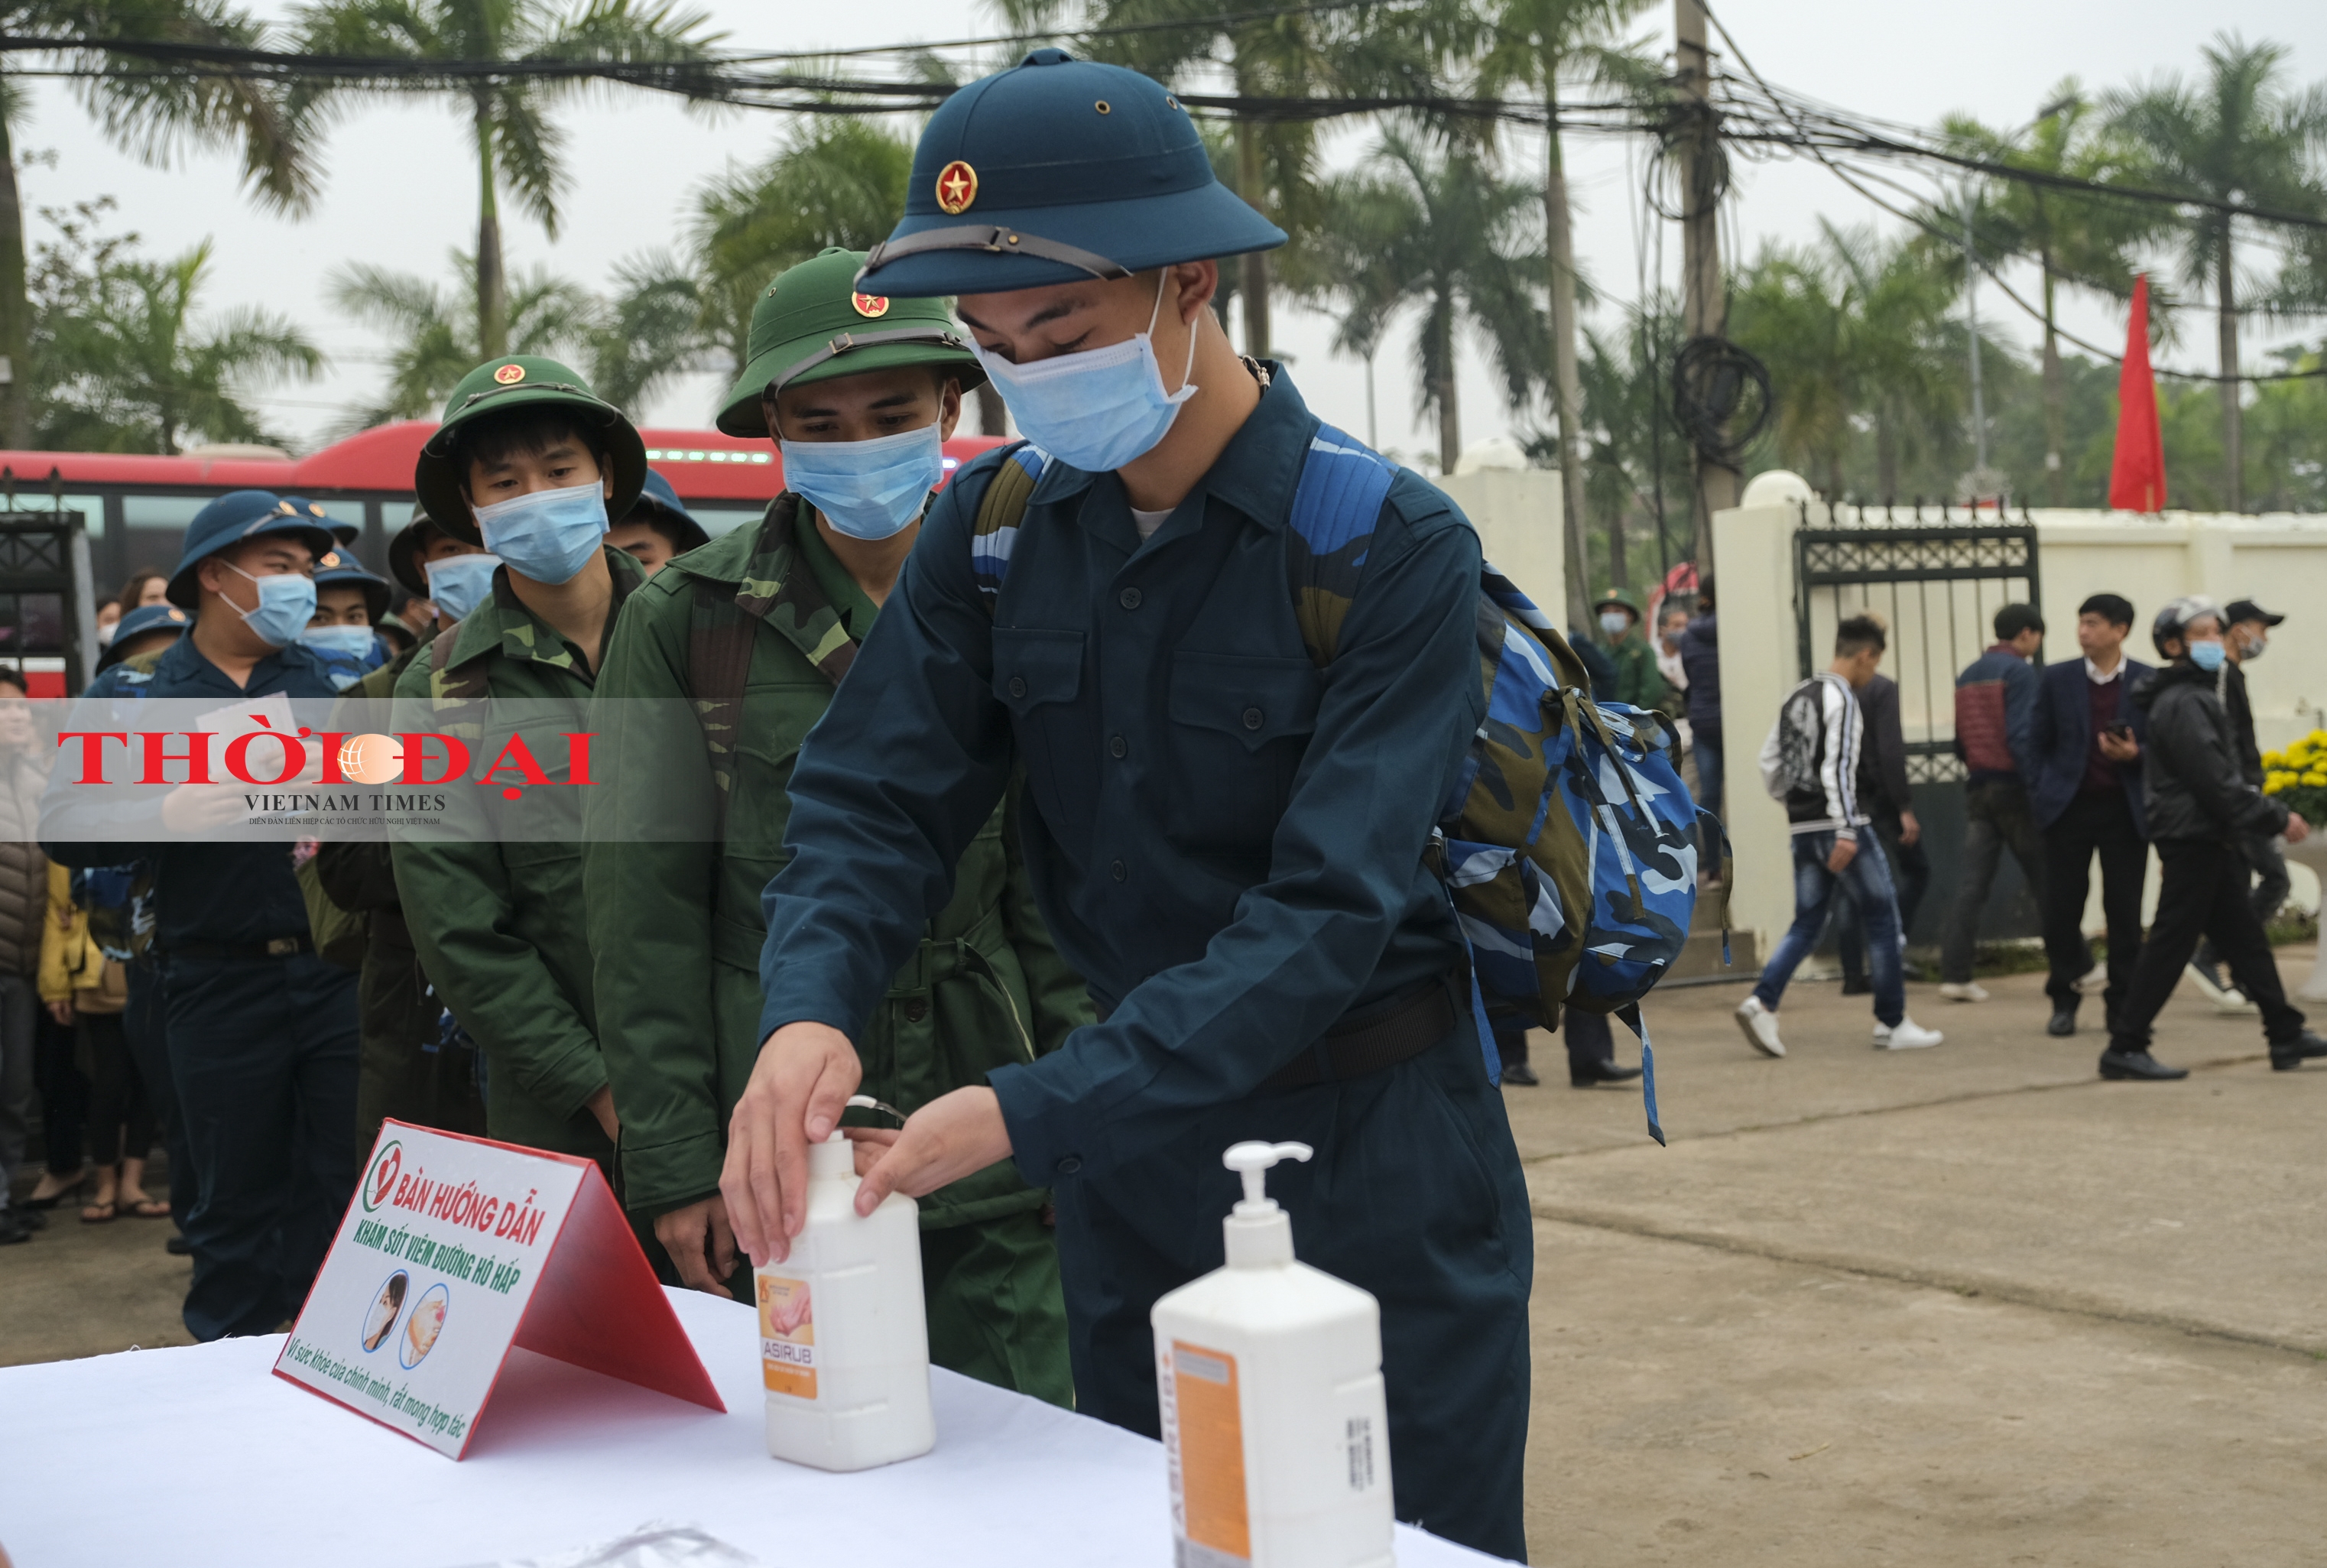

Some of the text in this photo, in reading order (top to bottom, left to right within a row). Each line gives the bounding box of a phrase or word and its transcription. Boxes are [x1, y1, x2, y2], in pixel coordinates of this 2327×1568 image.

[392, 1166, 546, 1246] BÀN HƯỚNG DẪN
[353, 1218, 521, 1295] KHÁM SỐT VIÊM ĐƯỜNG HÔ HẤP
[287, 1337, 301, 1358] Vì
[294, 1343, 313, 1365] sức
[309, 1348, 332, 1374] khỏe
[329, 1358, 346, 1381] của
[344, 1365, 370, 1392] chính
[389, 1382, 408, 1410] rất
[402, 1397, 431, 1427] mong
[427, 1403, 450, 1435] hợp
[447, 1414, 466, 1439] tác
[764, 1342, 812, 1365] ASIRUB
